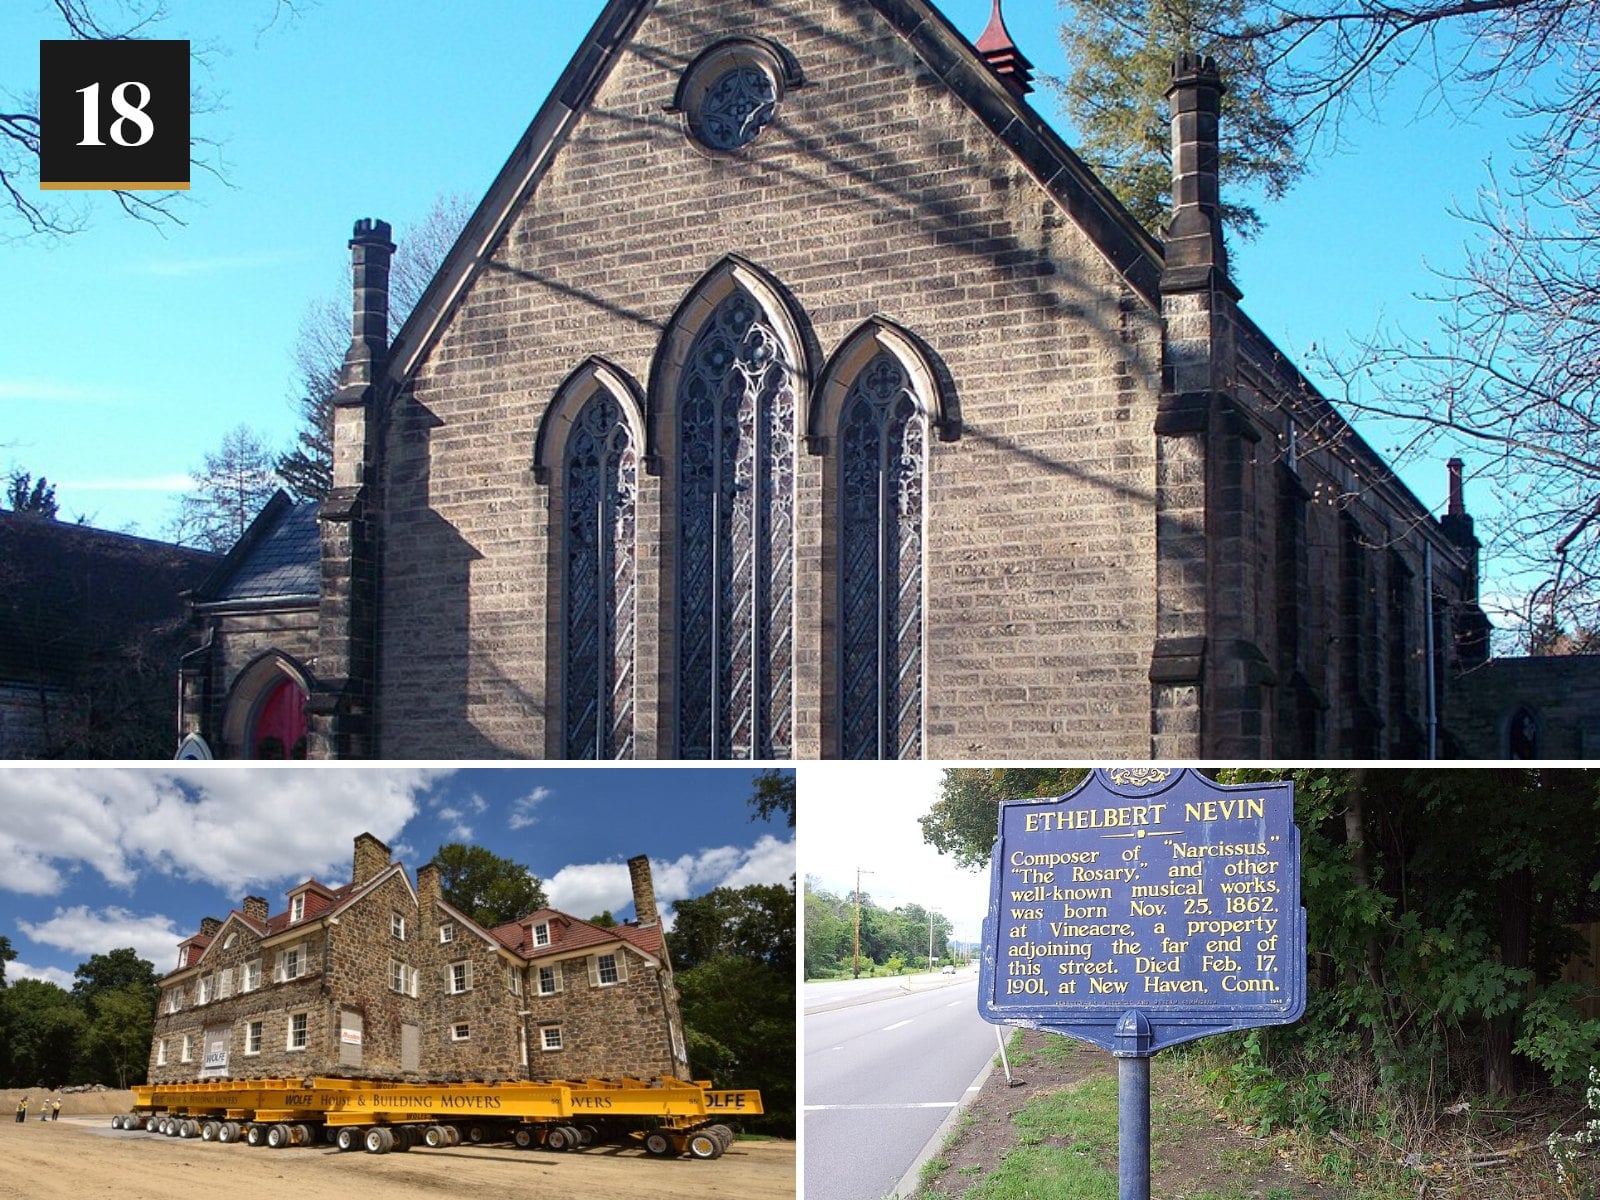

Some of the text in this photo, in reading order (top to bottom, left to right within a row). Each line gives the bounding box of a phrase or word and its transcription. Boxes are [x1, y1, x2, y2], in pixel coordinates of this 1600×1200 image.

[1025, 798, 1265, 832] ETHELBERT NEVIN
[1010, 851, 1100, 869] Composer
[1121, 845, 1142, 861] of
[1168, 861, 1203, 878] and
[1224, 859, 1279, 876] other
[1011, 877, 1281, 902] well-known musical works,
[1011, 907, 1044, 920] was
[1064, 903, 1108, 920] born
[1129, 900, 1168, 917] Nov.
[1184, 898, 1213, 915] 25,
[1009, 916, 1277, 938] at Vineacre, a property
[1008, 934, 1279, 960] adjoining the far end of
[1008, 954, 1279, 976] this street. Died Feb. 17,
[1006, 975, 1280, 997] 1901, at New Haven, Conn.
[285, 1094, 313, 1106] WOLFE
[357, 1095, 366, 1106] &
